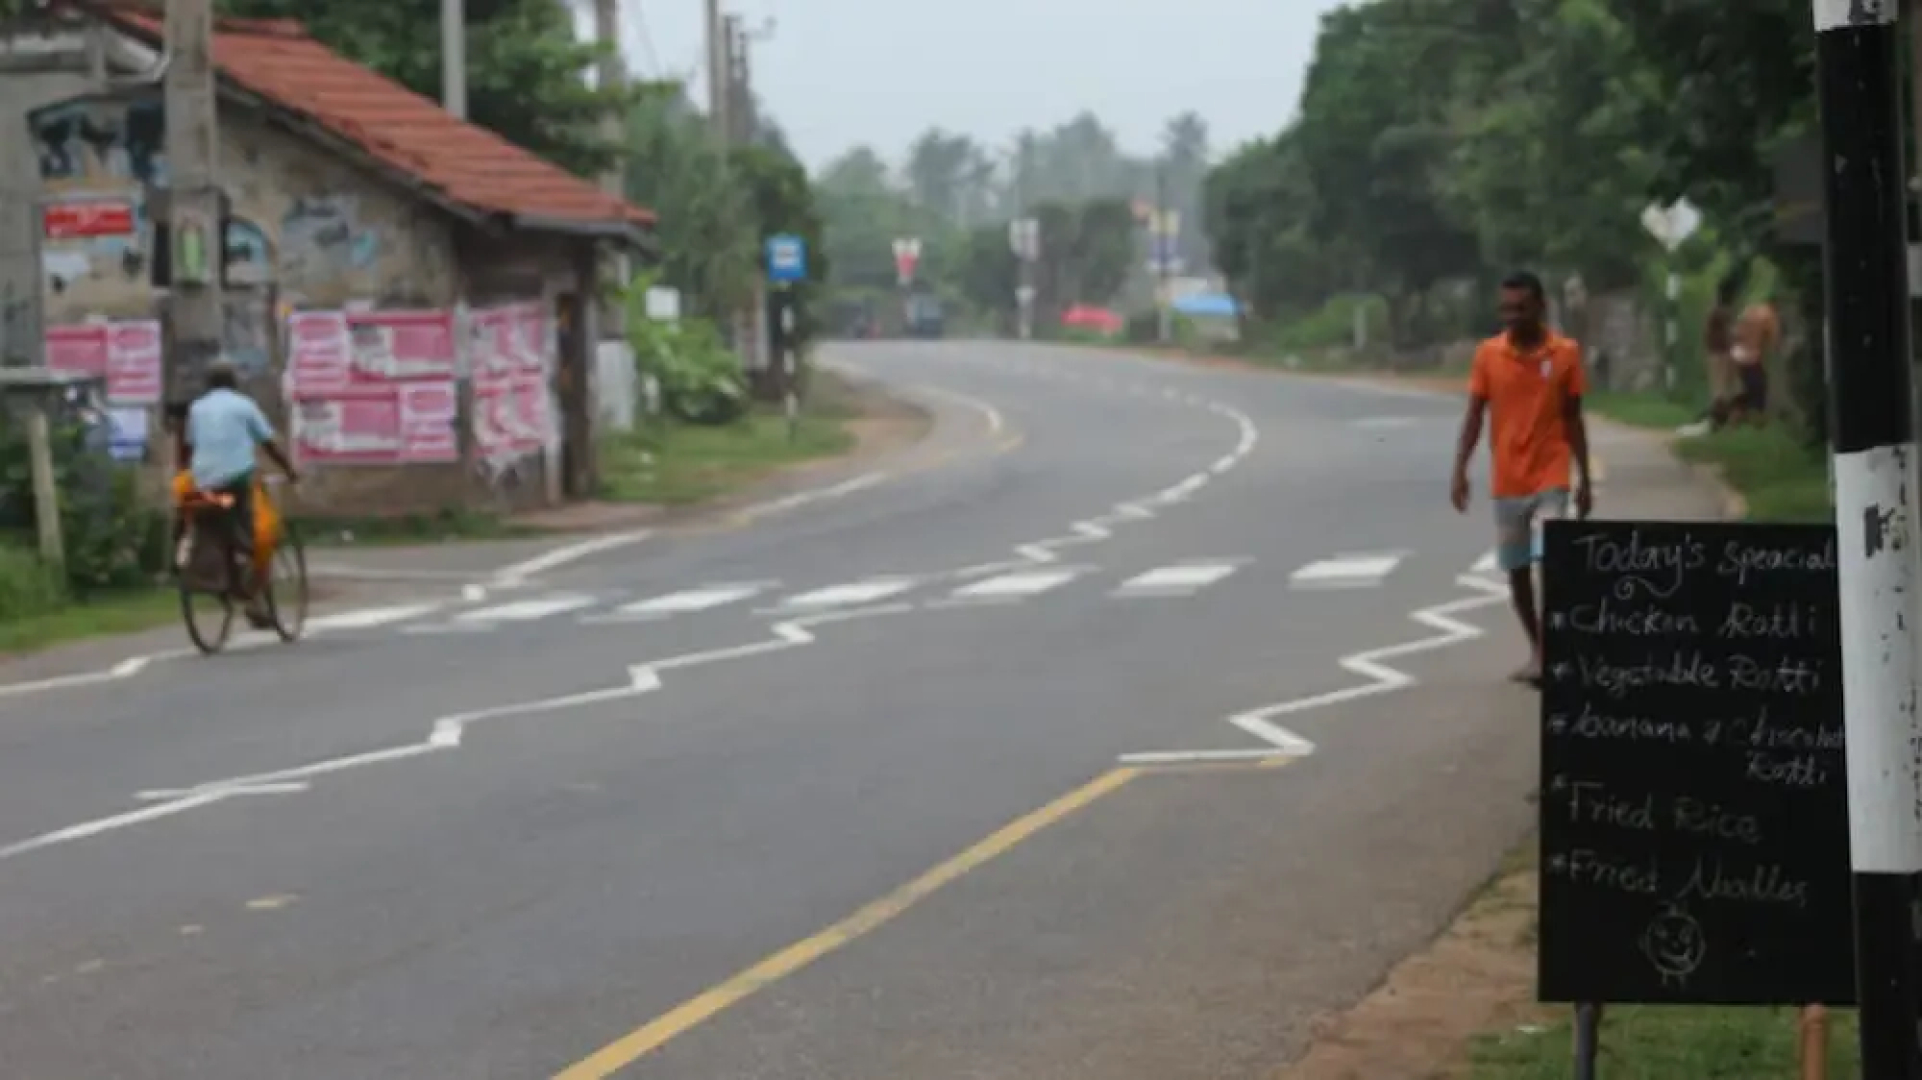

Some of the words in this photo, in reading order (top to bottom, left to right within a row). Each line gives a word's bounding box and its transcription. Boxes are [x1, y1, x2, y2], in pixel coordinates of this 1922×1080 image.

[1572, 530, 1706, 599] Today's
[1570, 596, 1700, 635] Chicken
[1575, 648, 1719, 698] Vegetable
[1567, 781, 1655, 830] Fried
[1673, 796, 1763, 844] Rice
[1568, 848, 1658, 894] Fried
